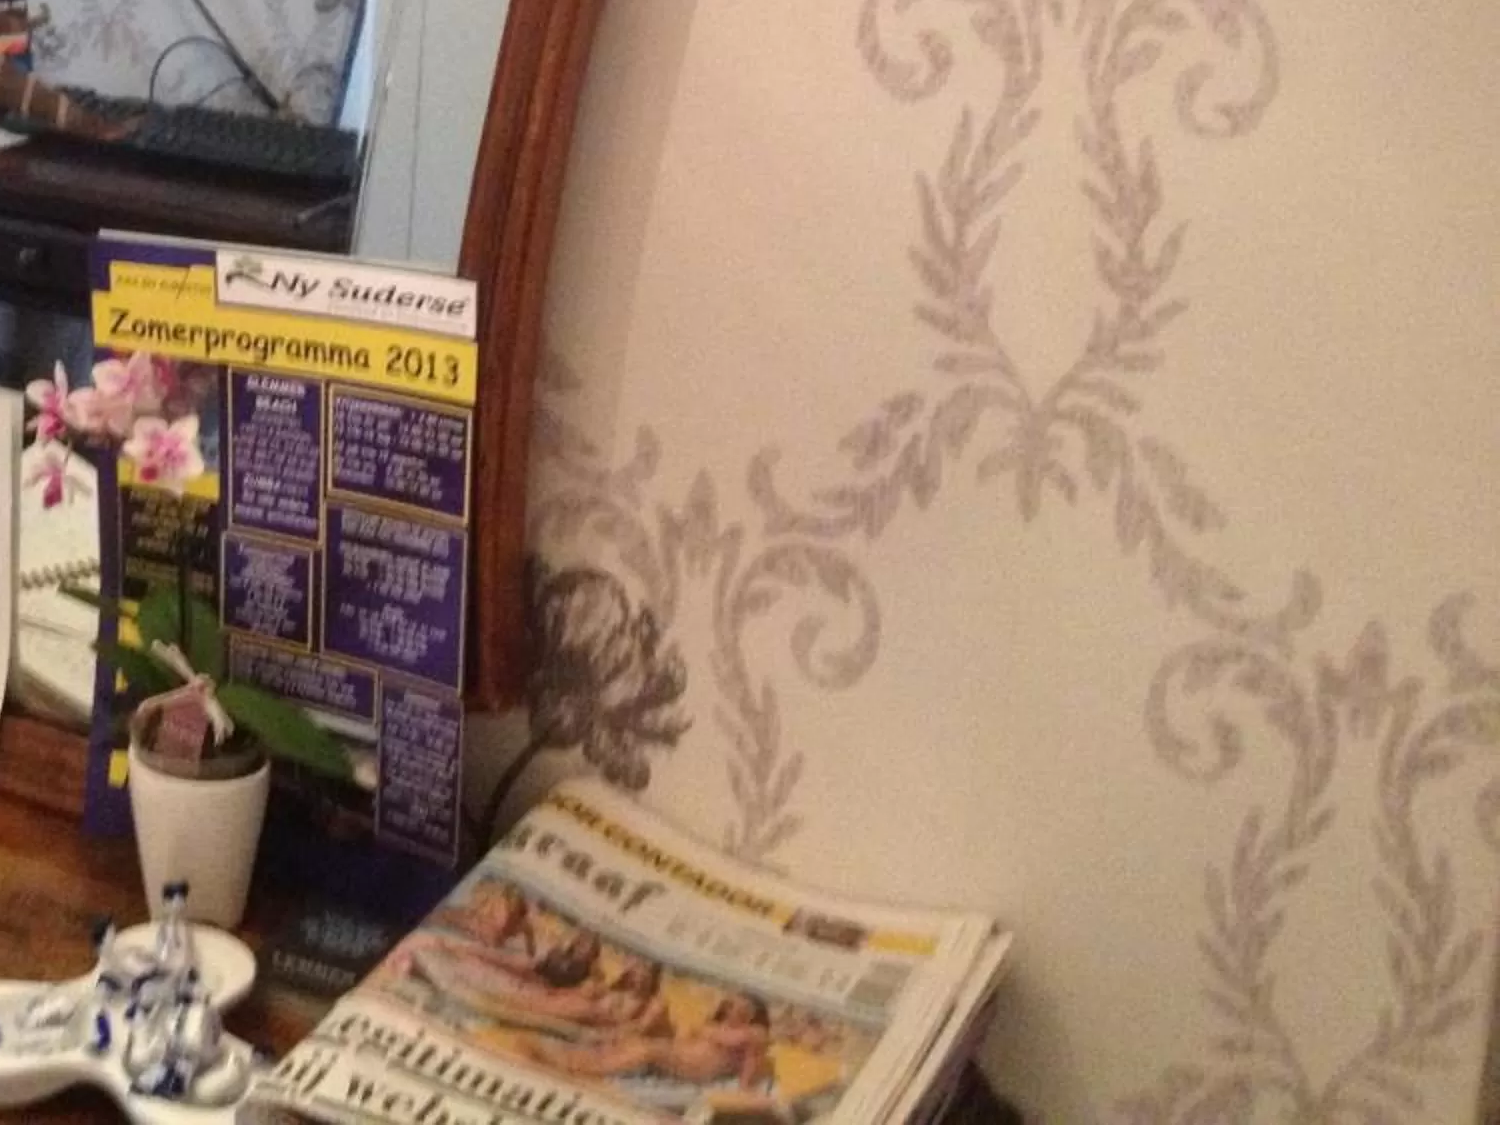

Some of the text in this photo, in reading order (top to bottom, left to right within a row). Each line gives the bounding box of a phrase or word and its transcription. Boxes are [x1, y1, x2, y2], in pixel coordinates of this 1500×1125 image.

[269, 270, 320, 300] Ny
[109, 307, 370, 371] Zomerprogramma
[385, 344, 460, 387] 2013
